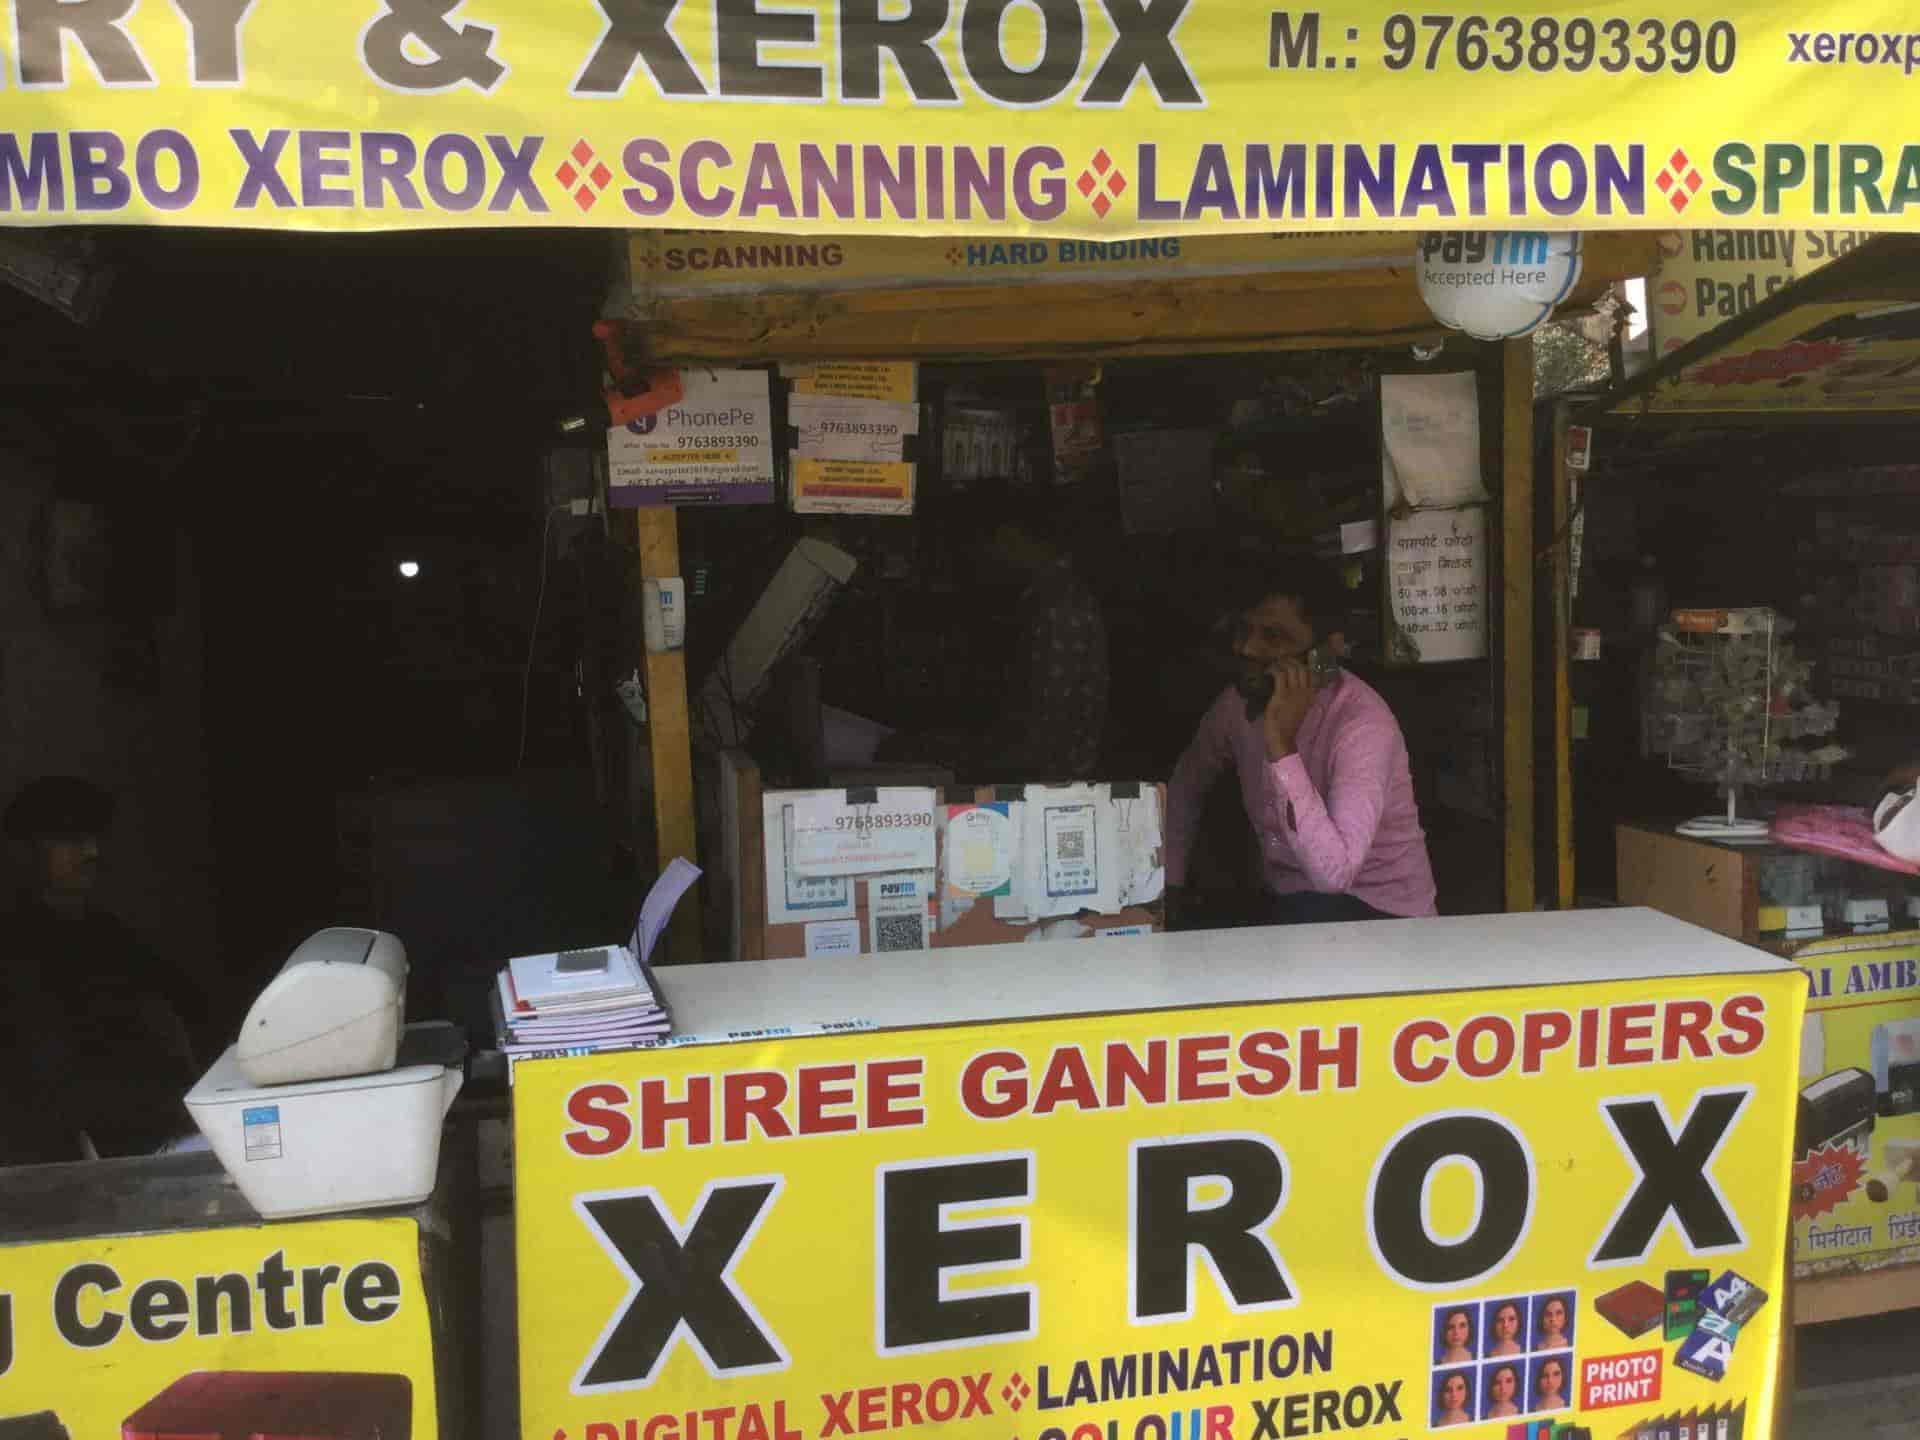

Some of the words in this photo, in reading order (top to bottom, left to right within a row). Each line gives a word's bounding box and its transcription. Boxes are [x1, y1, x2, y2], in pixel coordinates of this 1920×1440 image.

[363, 0, 508, 92] &
[573, 0, 1204, 103] XEROX
[1269, 12, 1356, 69] M.:
[1383, 16, 1736, 74] 9763893390
[0, 129, 199, 210] MBO
[229, 129, 550, 212] XEROX
[622, 139, 1066, 220] SCANNING
[1137, 144, 1645, 220] LAMINATION
[664, 243, 843, 271] SCANNING
[967, 242, 1048, 266] HARD
[1058, 237, 1180, 263] BINDING
[1424, 270, 1495, 288] Accepted
[1502, 268, 1546, 285] Here
[1695, 273, 1756, 317] Pad
[667, 408, 754, 428] PhonePe
[677, 435, 759, 449] 9763893390
[564, 1059, 924, 1156] SHREE
[960, 1027, 1359, 1119] GANESH
[1392, 995, 1765, 1082] COPIERS
[54, 1250, 400, 1347] Centre
[1037, 1329, 1333, 1410] LAMINATION
[1586, 1355, 1657, 1383] PHOTO
[1589, 1378, 1653, 1405] PRINT
[820, 1371, 993, 1439] XEROX
[1251, 1380, 1403, 1440] XEROX
